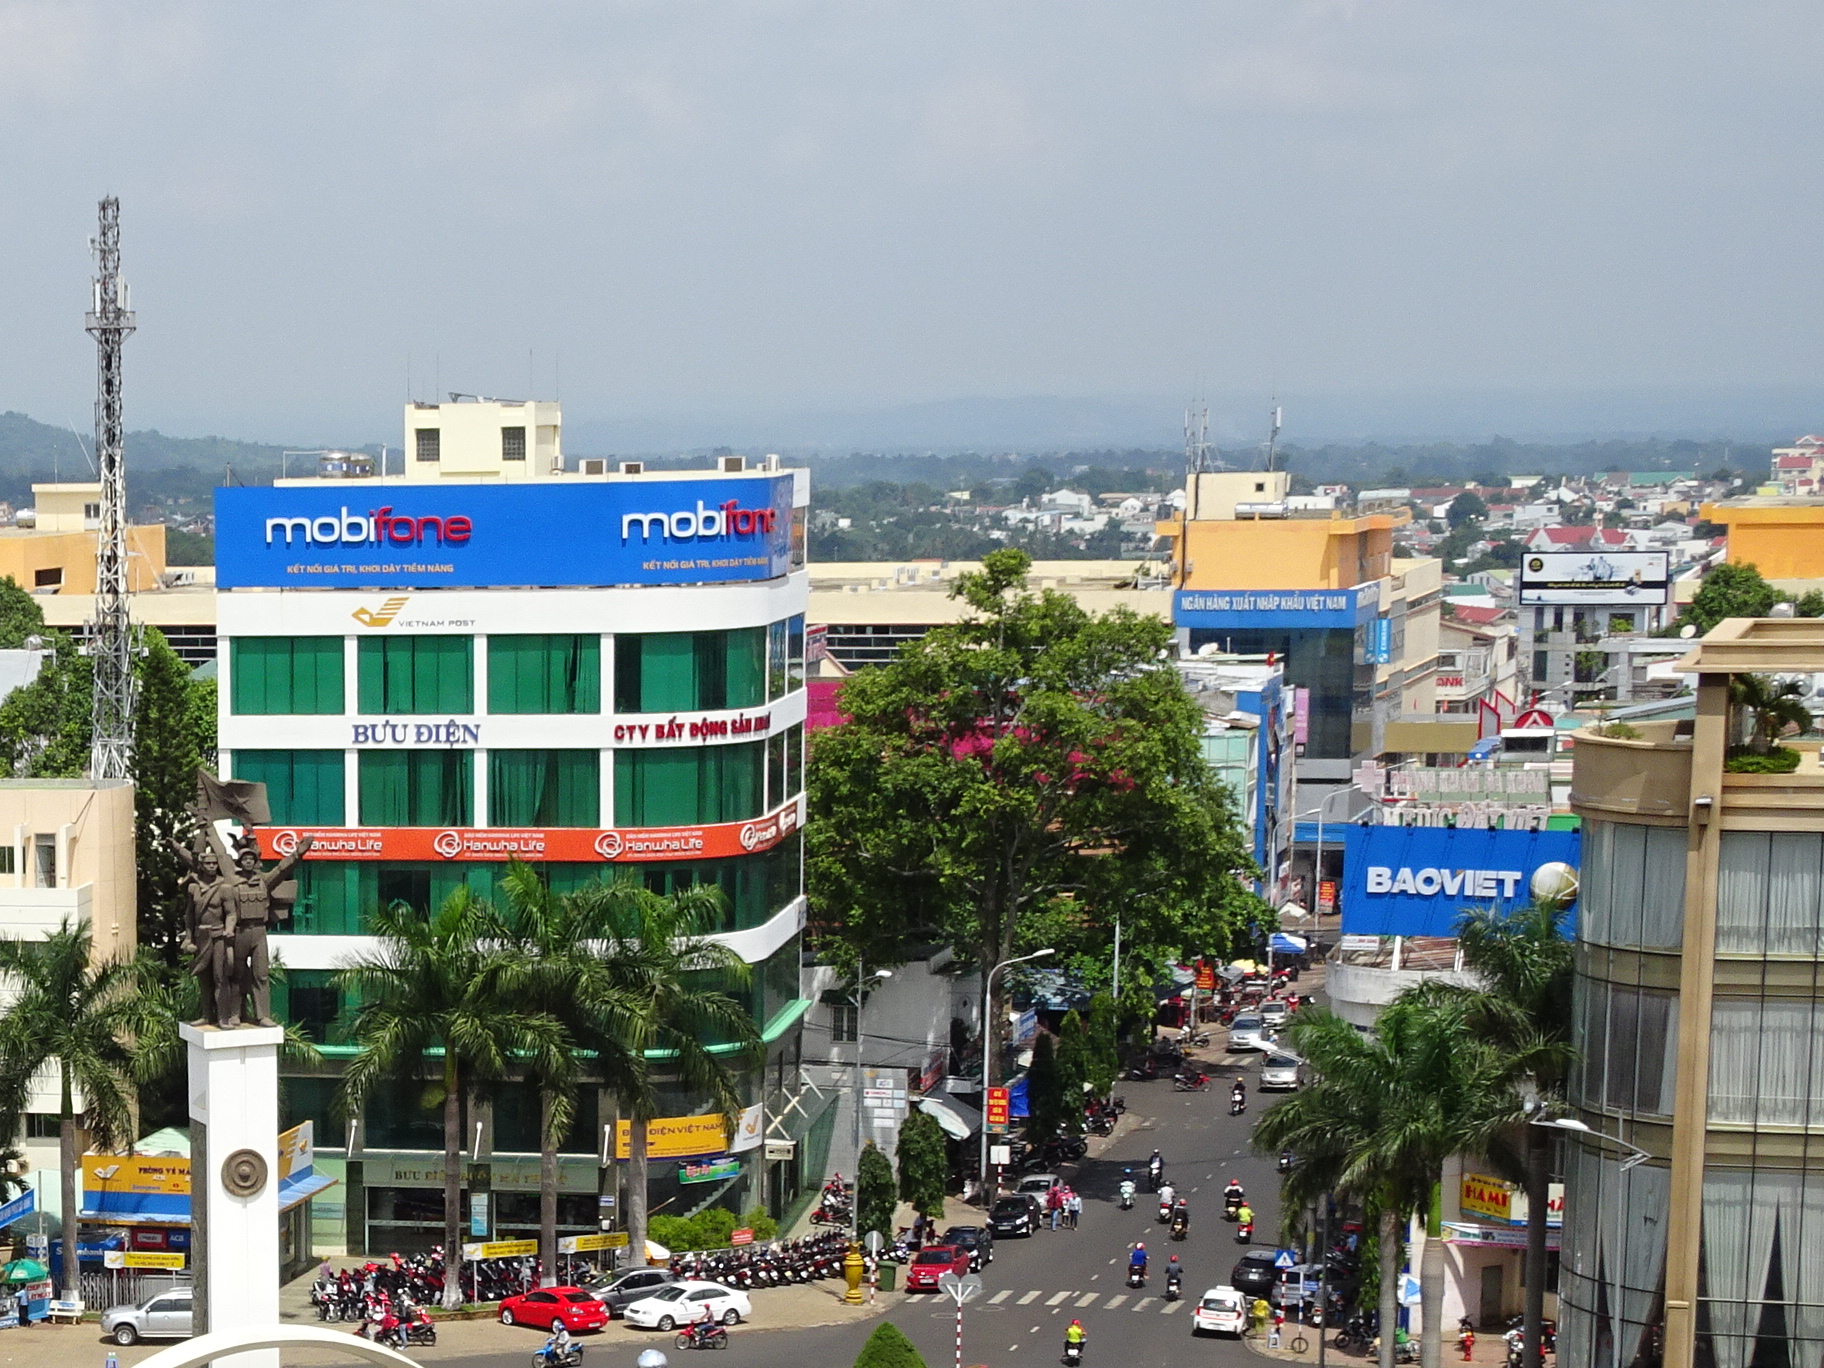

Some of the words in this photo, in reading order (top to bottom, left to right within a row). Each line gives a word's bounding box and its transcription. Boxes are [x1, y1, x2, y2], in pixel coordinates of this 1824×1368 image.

[266, 506, 473, 543] mobifone
[1325, 595, 1347, 611] NAM
[398, 620, 445, 628] VIETNAM
[448, 619, 477, 627] POST
[352, 720, 408, 745] BƯU
[414, 718, 481, 748] ĐIỆN
[614, 724, 649, 740] CTY
[655, 716, 685, 739] BẤT
[689, 717, 728, 743] ĐỘNG
[310, 839, 356, 850] anwha
[358, 840, 382, 851] Life
[464, 840, 518, 851] Hanwha
[520, 840, 545, 852] Life
[626, 839, 680, 852] Hanwha
[680, 838, 704, 850] Life
[1366, 866, 1522, 898] BAOVIET
[648, 1126, 676, 1137] ĐIỆN
[676, 1124, 702, 1134] VIỆT
[702, 1122, 724, 1131] NAM
